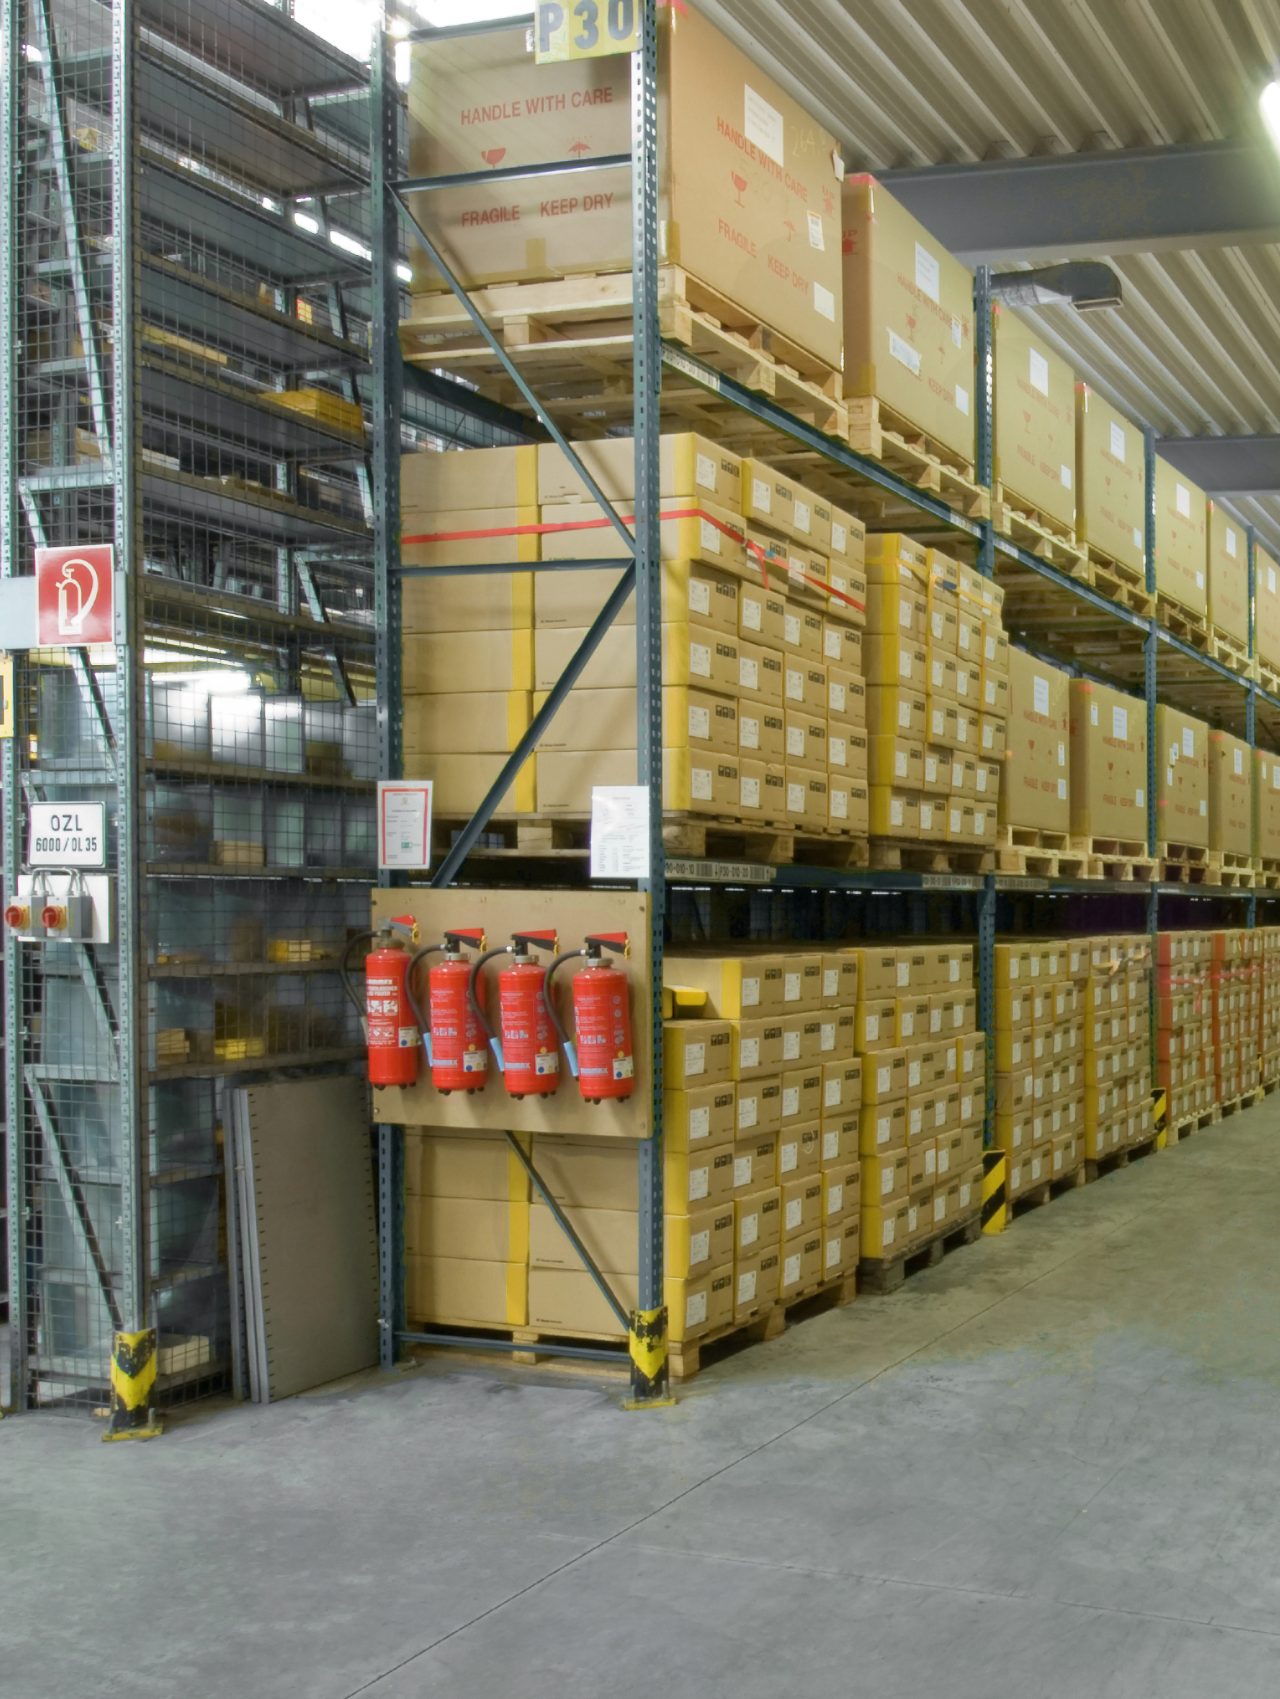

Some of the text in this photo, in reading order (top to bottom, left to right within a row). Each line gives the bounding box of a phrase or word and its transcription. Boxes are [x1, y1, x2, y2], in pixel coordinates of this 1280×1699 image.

[538, 0, 634, 52] P30
[460, 86, 613, 126] HANDLE WITH CARE
[716, 116, 756, 162] HANDLE
[784, 173, 808, 204] CARE
[461, 192, 614, 227] FRAGILE KEEP DRY
[718, 217, 757, 259] FRAGILE
[767, 254, 790, 281] KEEP
